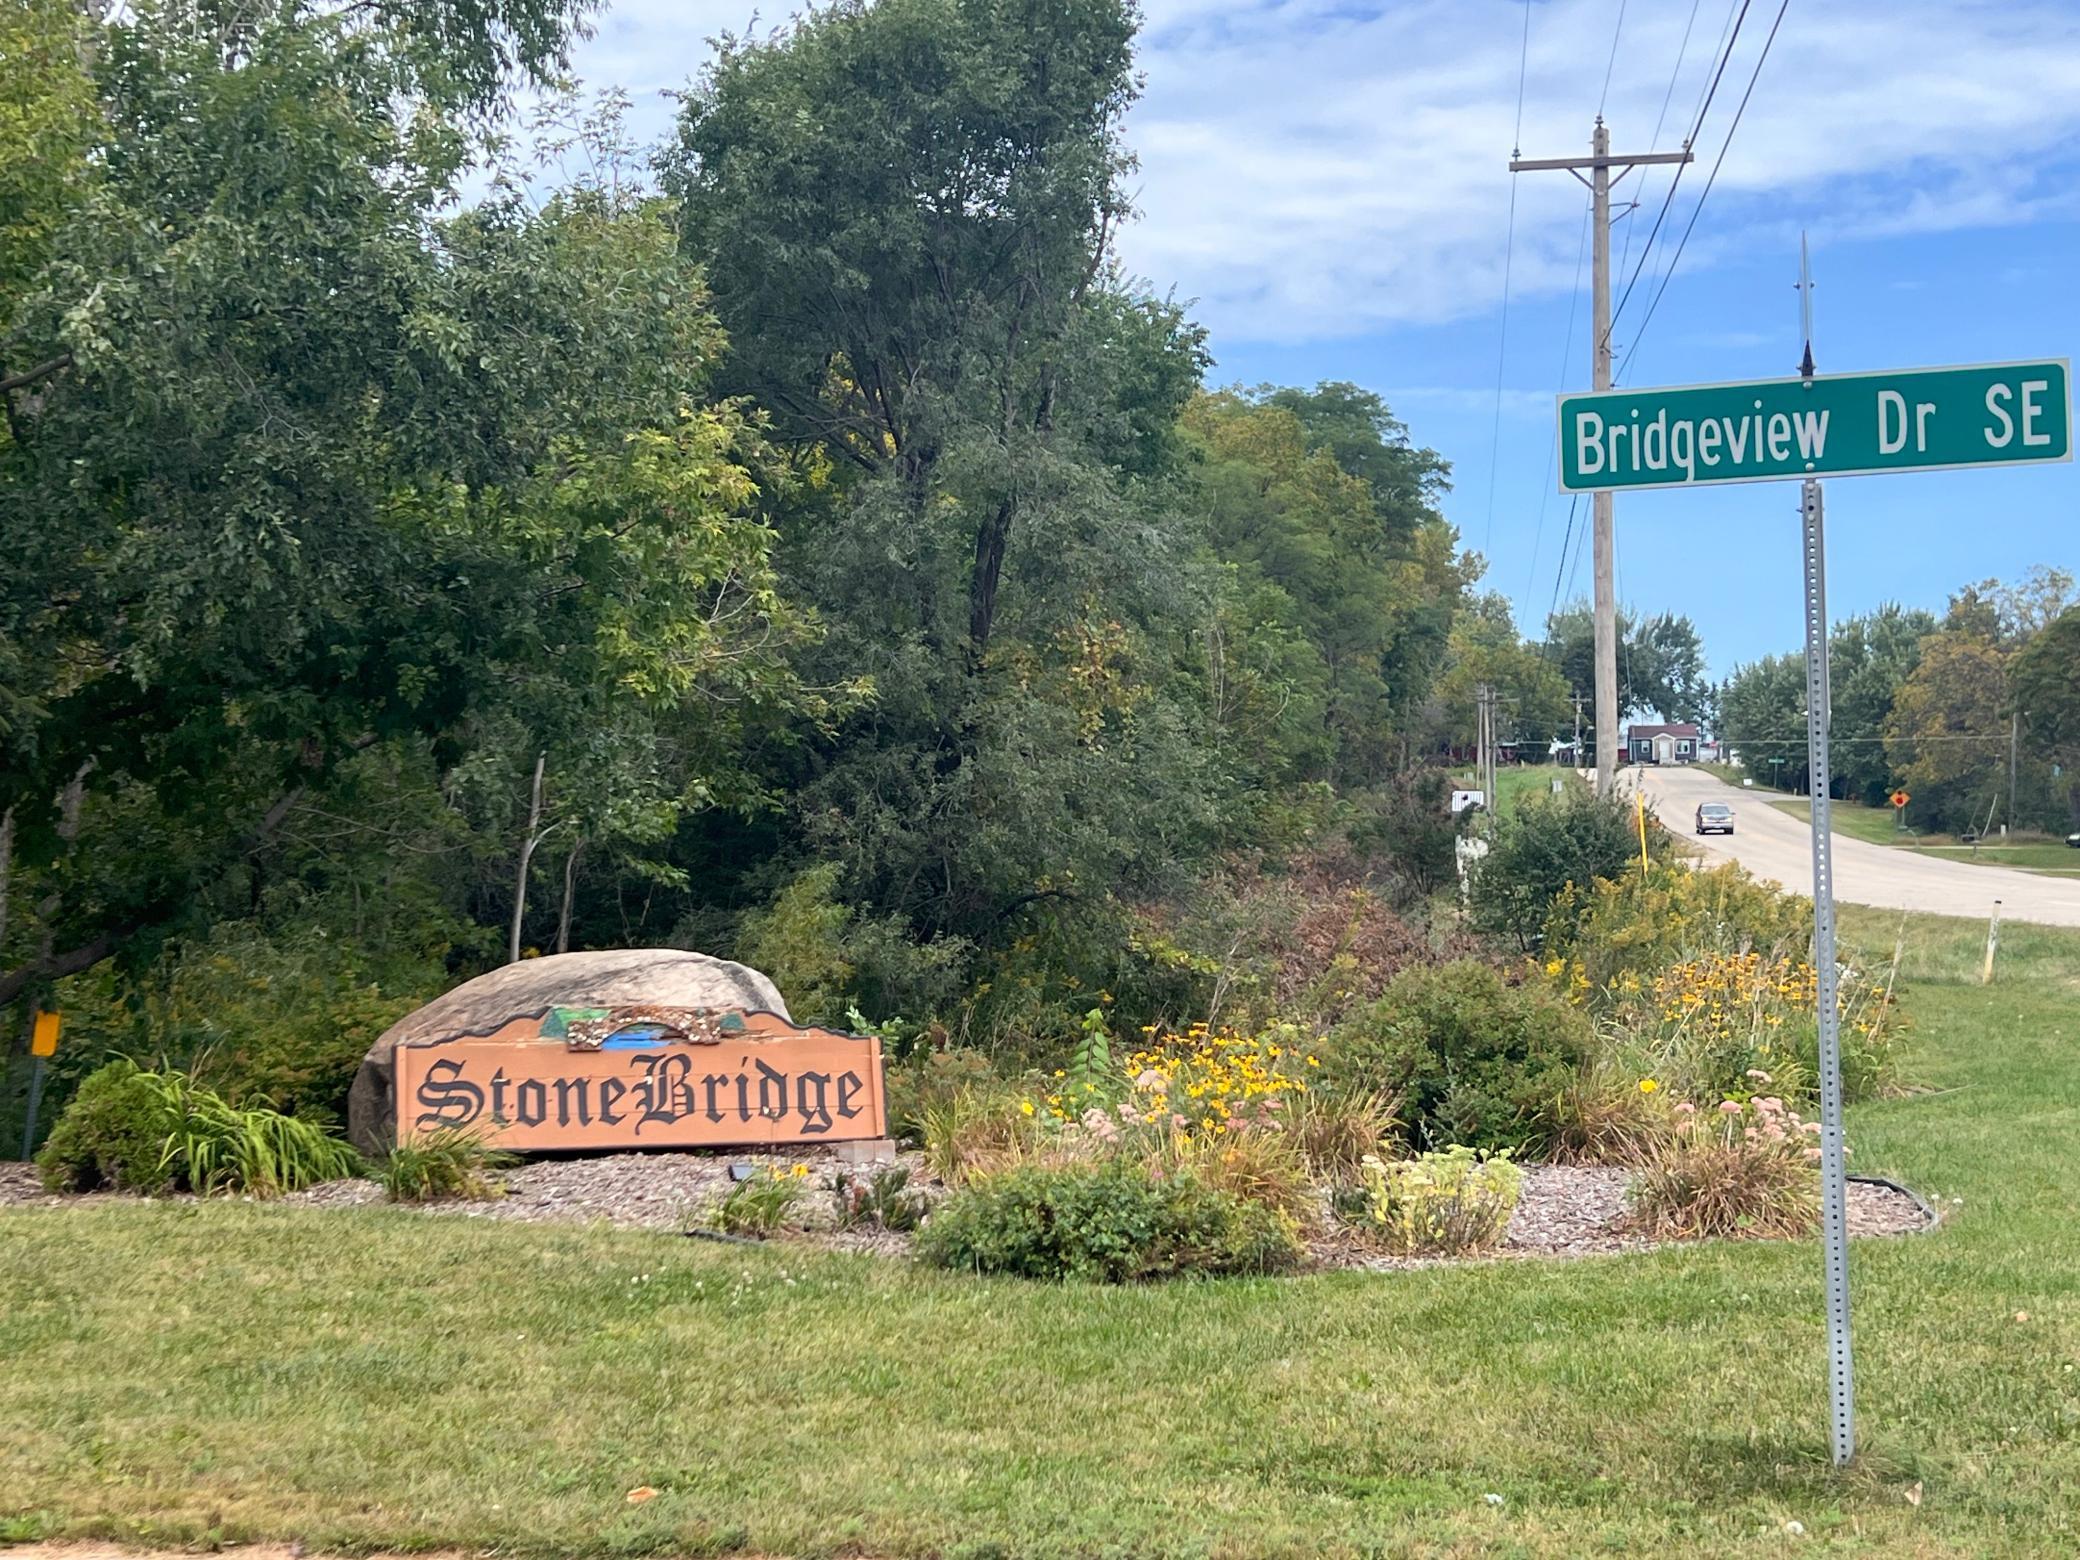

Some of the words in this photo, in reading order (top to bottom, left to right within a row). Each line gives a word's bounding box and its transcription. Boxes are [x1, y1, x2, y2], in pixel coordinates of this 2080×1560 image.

[1576, 400, 1830, 482] Bridgeview
[1877, 390, 1936, 455] Dr
[1984, 380, 2051, 448] SE
